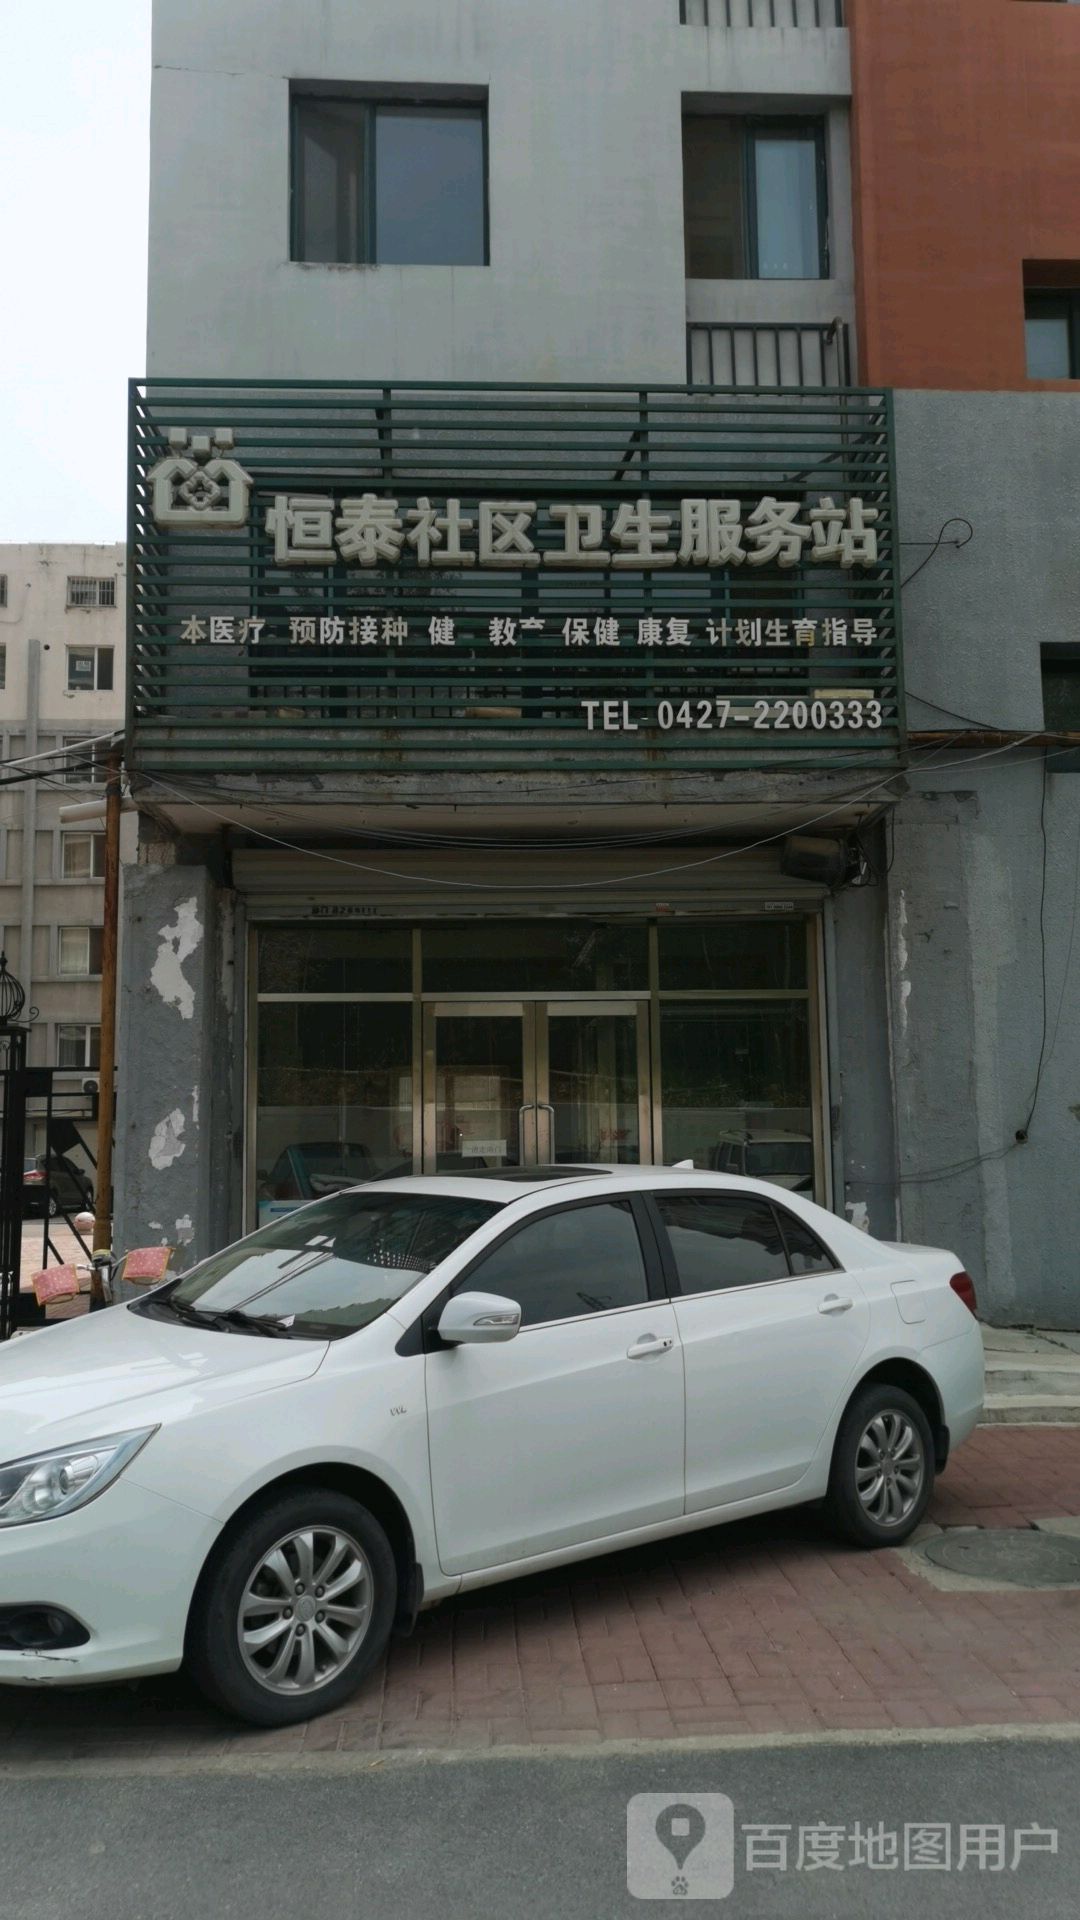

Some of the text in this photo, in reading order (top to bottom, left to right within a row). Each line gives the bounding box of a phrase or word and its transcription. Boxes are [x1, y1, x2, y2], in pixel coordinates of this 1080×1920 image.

[265, 493, 879, 568] 恒泰社区卫生服务站
[180, 615, 266, 645] 本医疗
[288, 616, 408, 646] 预防接种
[562, 617, 620, 646] 保健
[637, 617, 692, 646] 康复
[706, 617, 878, 647] 计划生育指导
[657, 699, 882, 730] 0427-2200333
